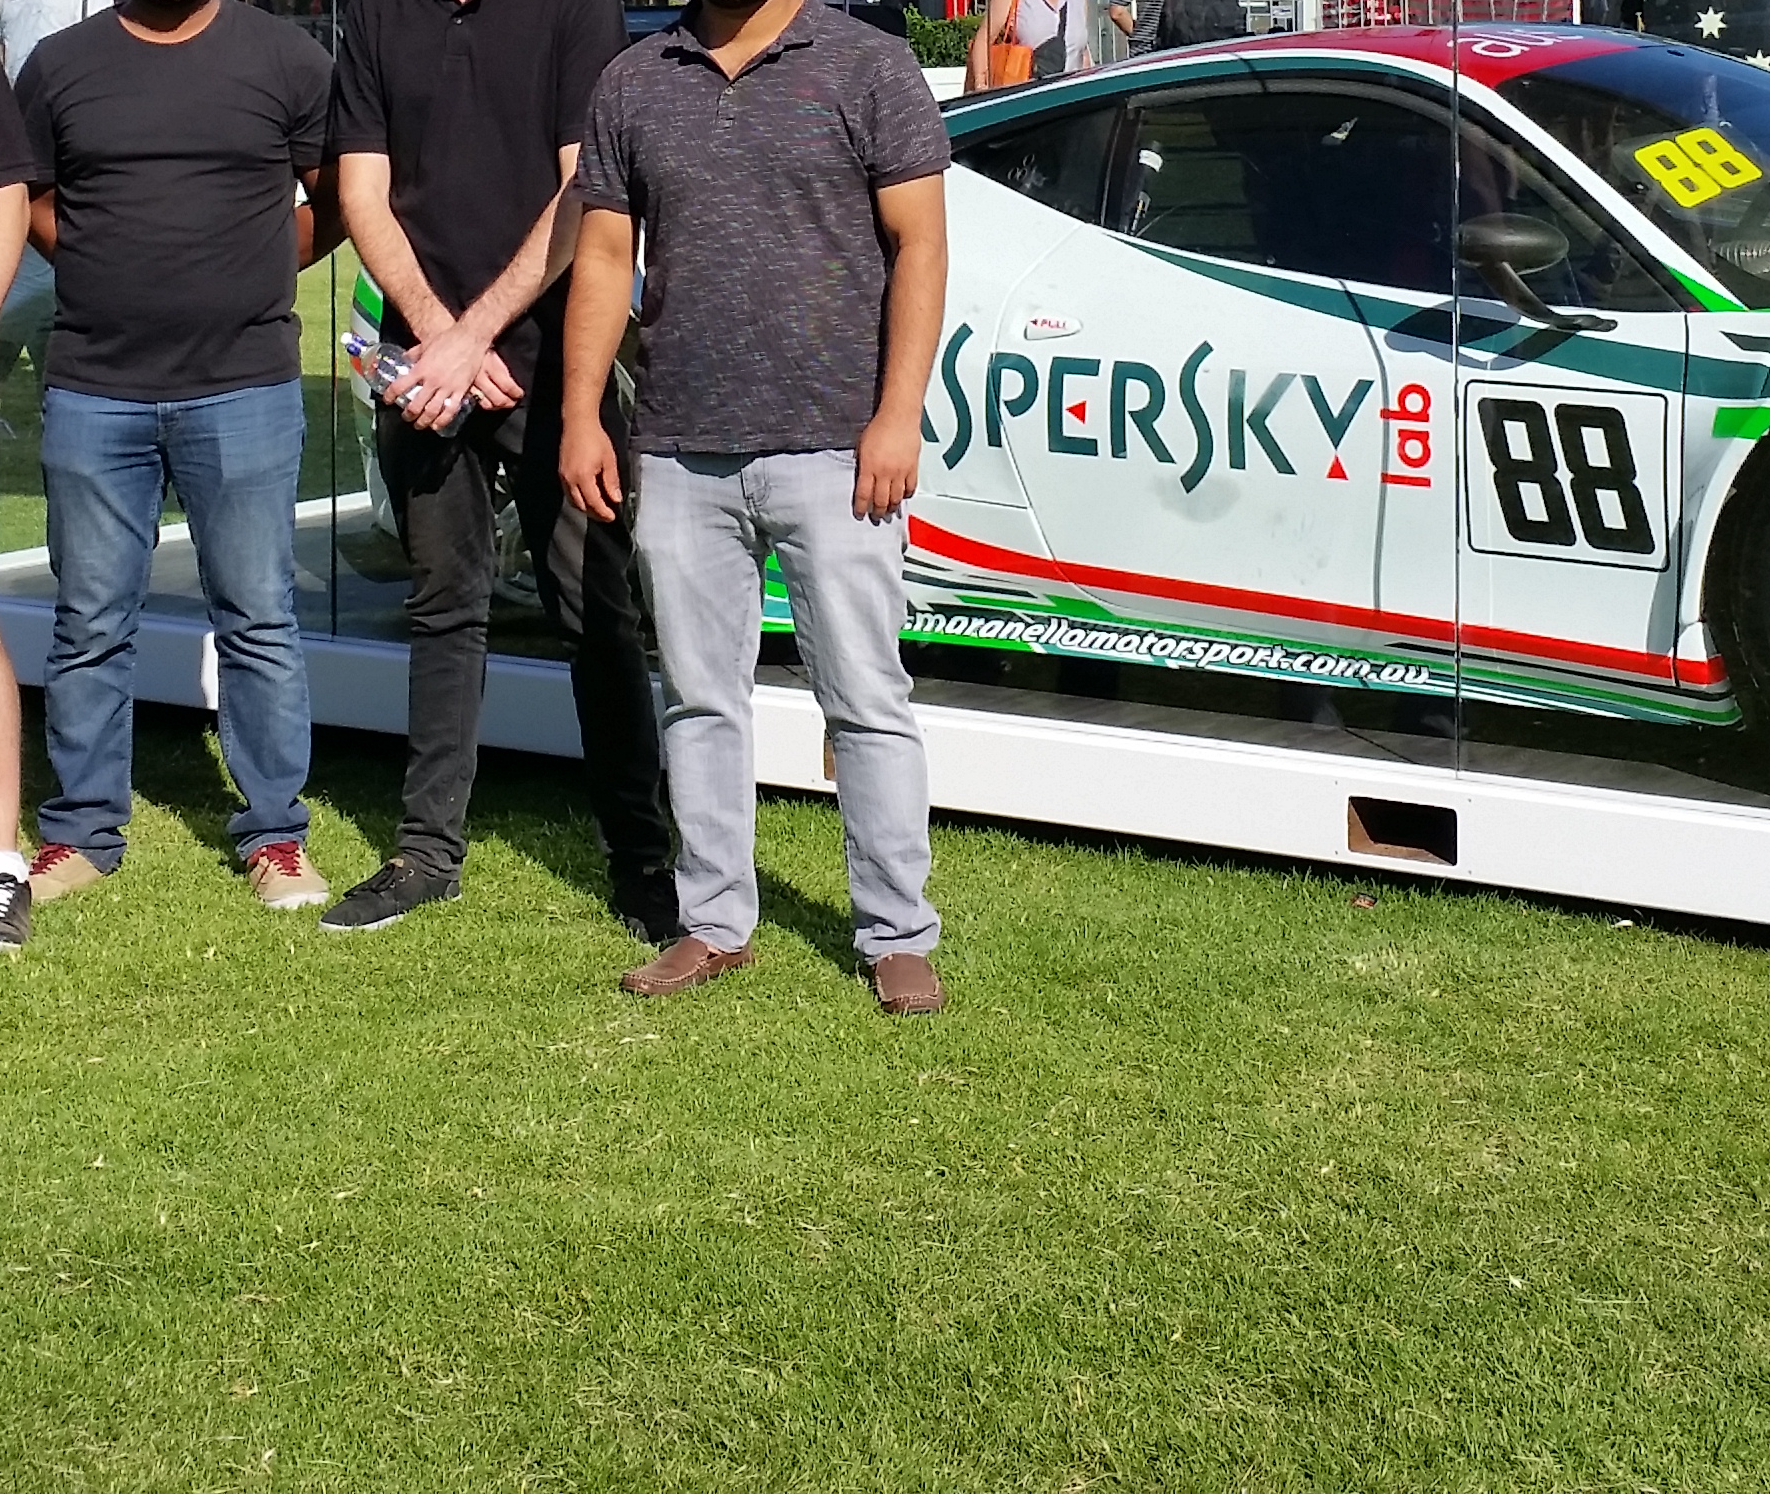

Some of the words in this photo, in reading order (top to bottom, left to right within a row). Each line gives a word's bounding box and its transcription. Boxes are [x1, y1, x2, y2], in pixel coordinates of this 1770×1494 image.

[1633, 127, 1763, 208] 88
[922, 322, 1375, 494] SPERSKY
[1477, 397, 1656, 554] 88
